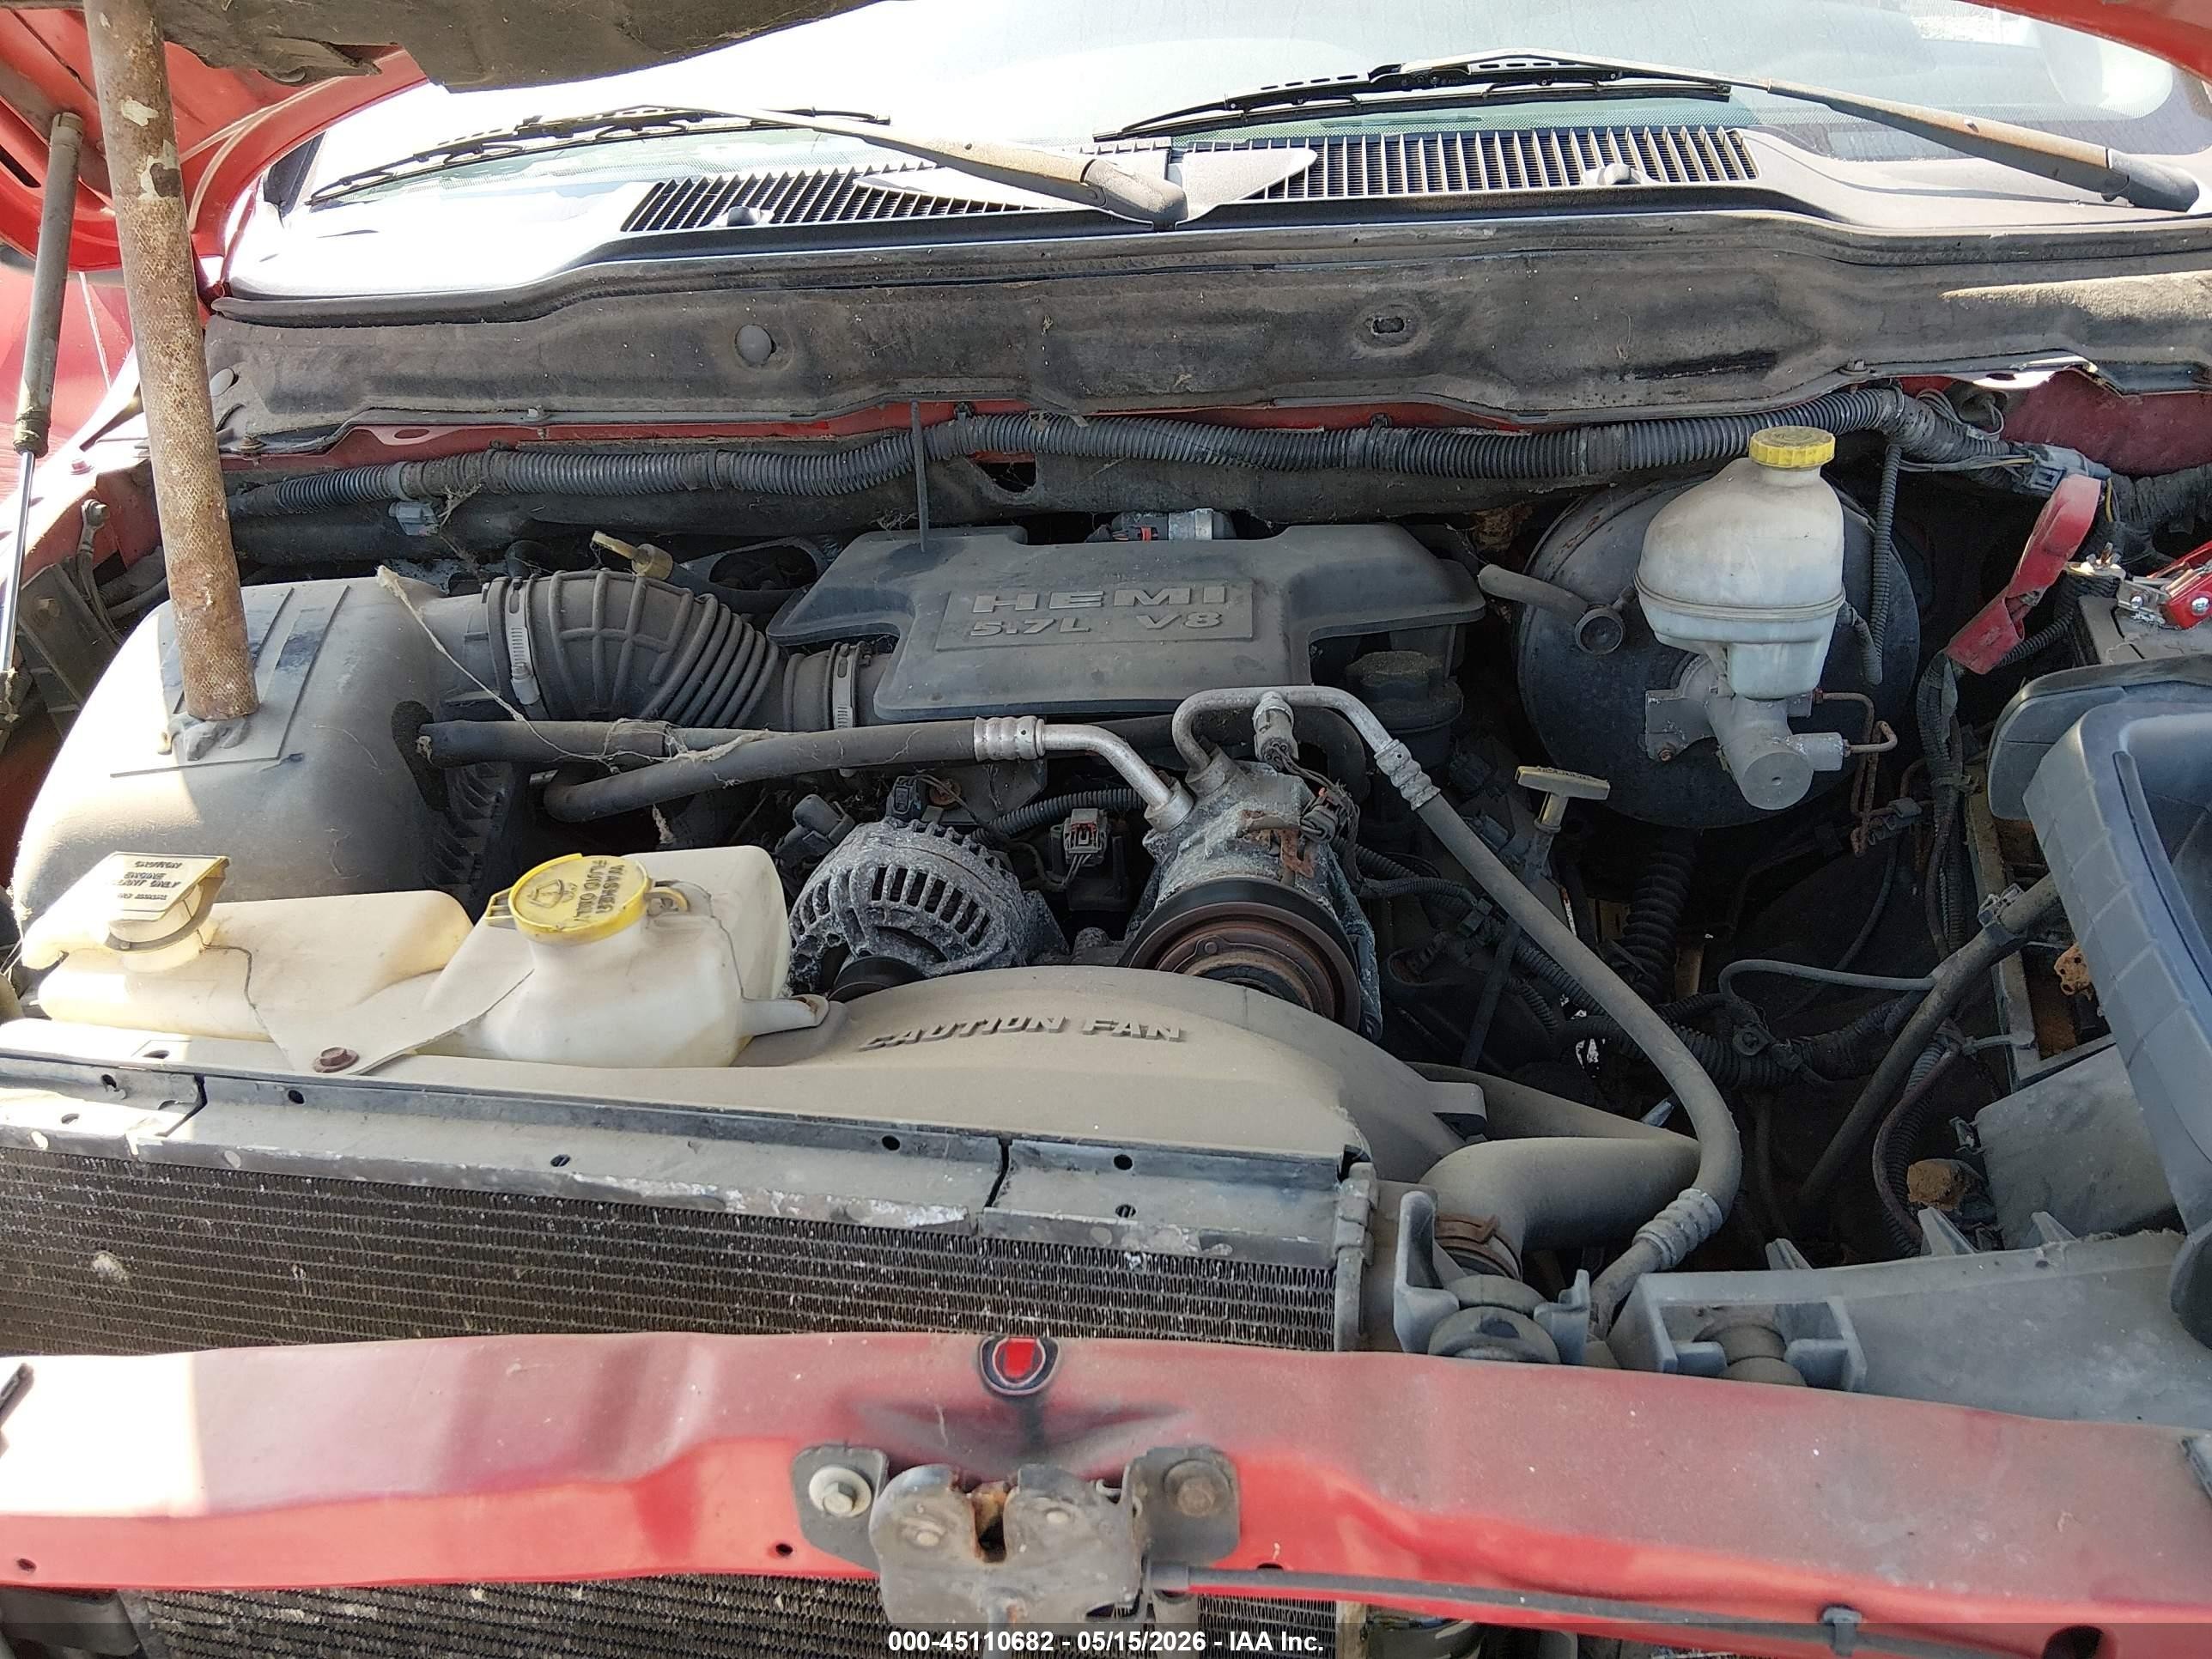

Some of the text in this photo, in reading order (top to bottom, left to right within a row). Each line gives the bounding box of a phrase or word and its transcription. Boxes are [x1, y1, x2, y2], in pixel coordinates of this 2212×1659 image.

[972, 586, 1225, 613] HEMI
[969, 611, 1223, 637] 5.7L V8
[573, 860, 608, 922] FLUID ONLY
[595, 864, 625, 915] WASHER
[859, 1016, 1185, 1053] CAUTION FAN
